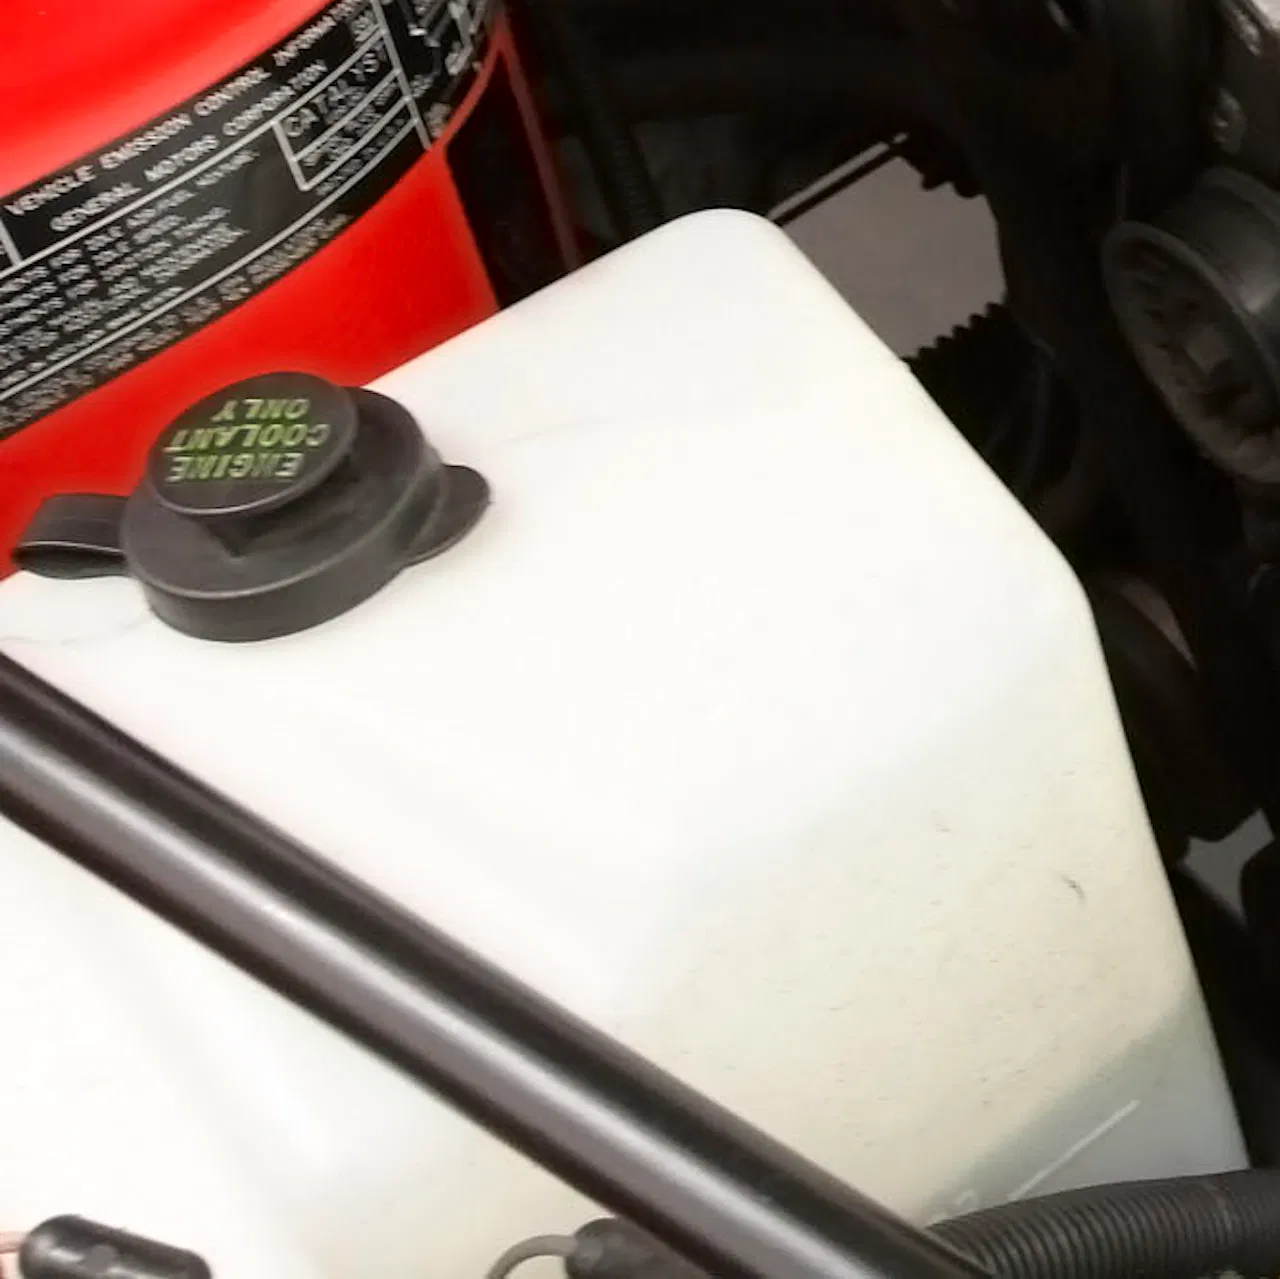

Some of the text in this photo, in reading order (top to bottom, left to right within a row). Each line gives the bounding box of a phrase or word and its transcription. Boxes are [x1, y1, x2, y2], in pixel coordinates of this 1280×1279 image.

[3, 165, 97, 215] VEHICLE
[99, 113, 193, 169] EMISSION
[194, 67, 271, 116] CONTROL
[50, 59, 327, 231] GENERAL MOTORS CORPORATION
[210, 398, 309, 422] ONLY
[163, 423, 331, 453] COOLANT
[165, 452, 304, 483] ENGINE
